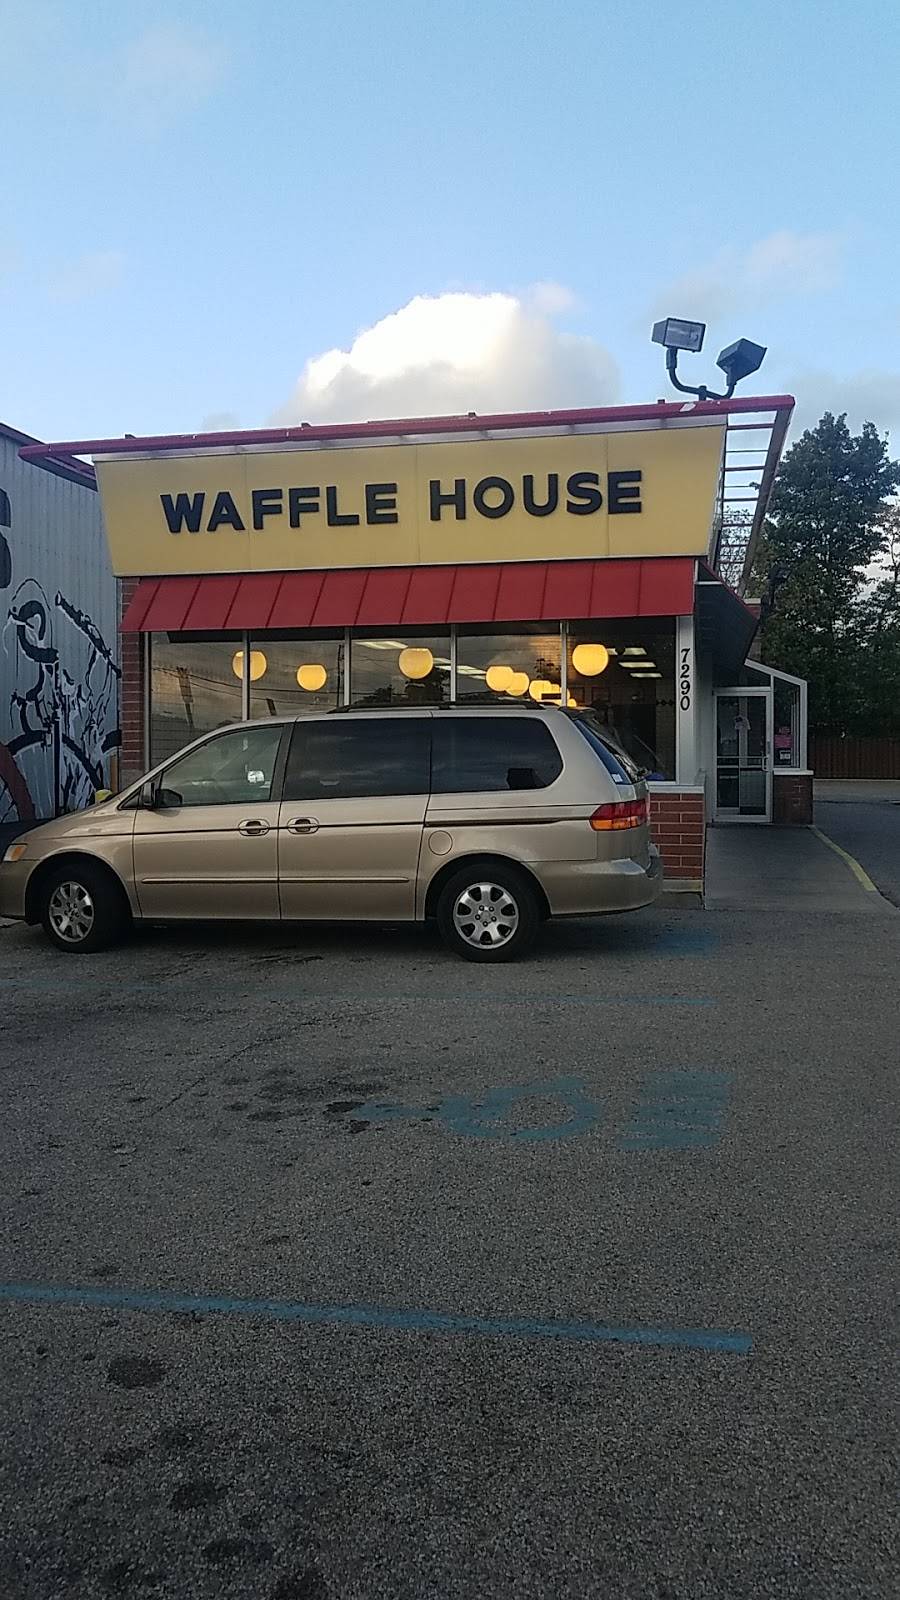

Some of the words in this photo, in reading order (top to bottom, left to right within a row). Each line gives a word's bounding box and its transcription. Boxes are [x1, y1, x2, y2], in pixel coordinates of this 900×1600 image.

[159, 482, 399, 535] WAFFLE
[429, 469, 643, 522] HOUSE
[679, 647, 691, 711] 7290
